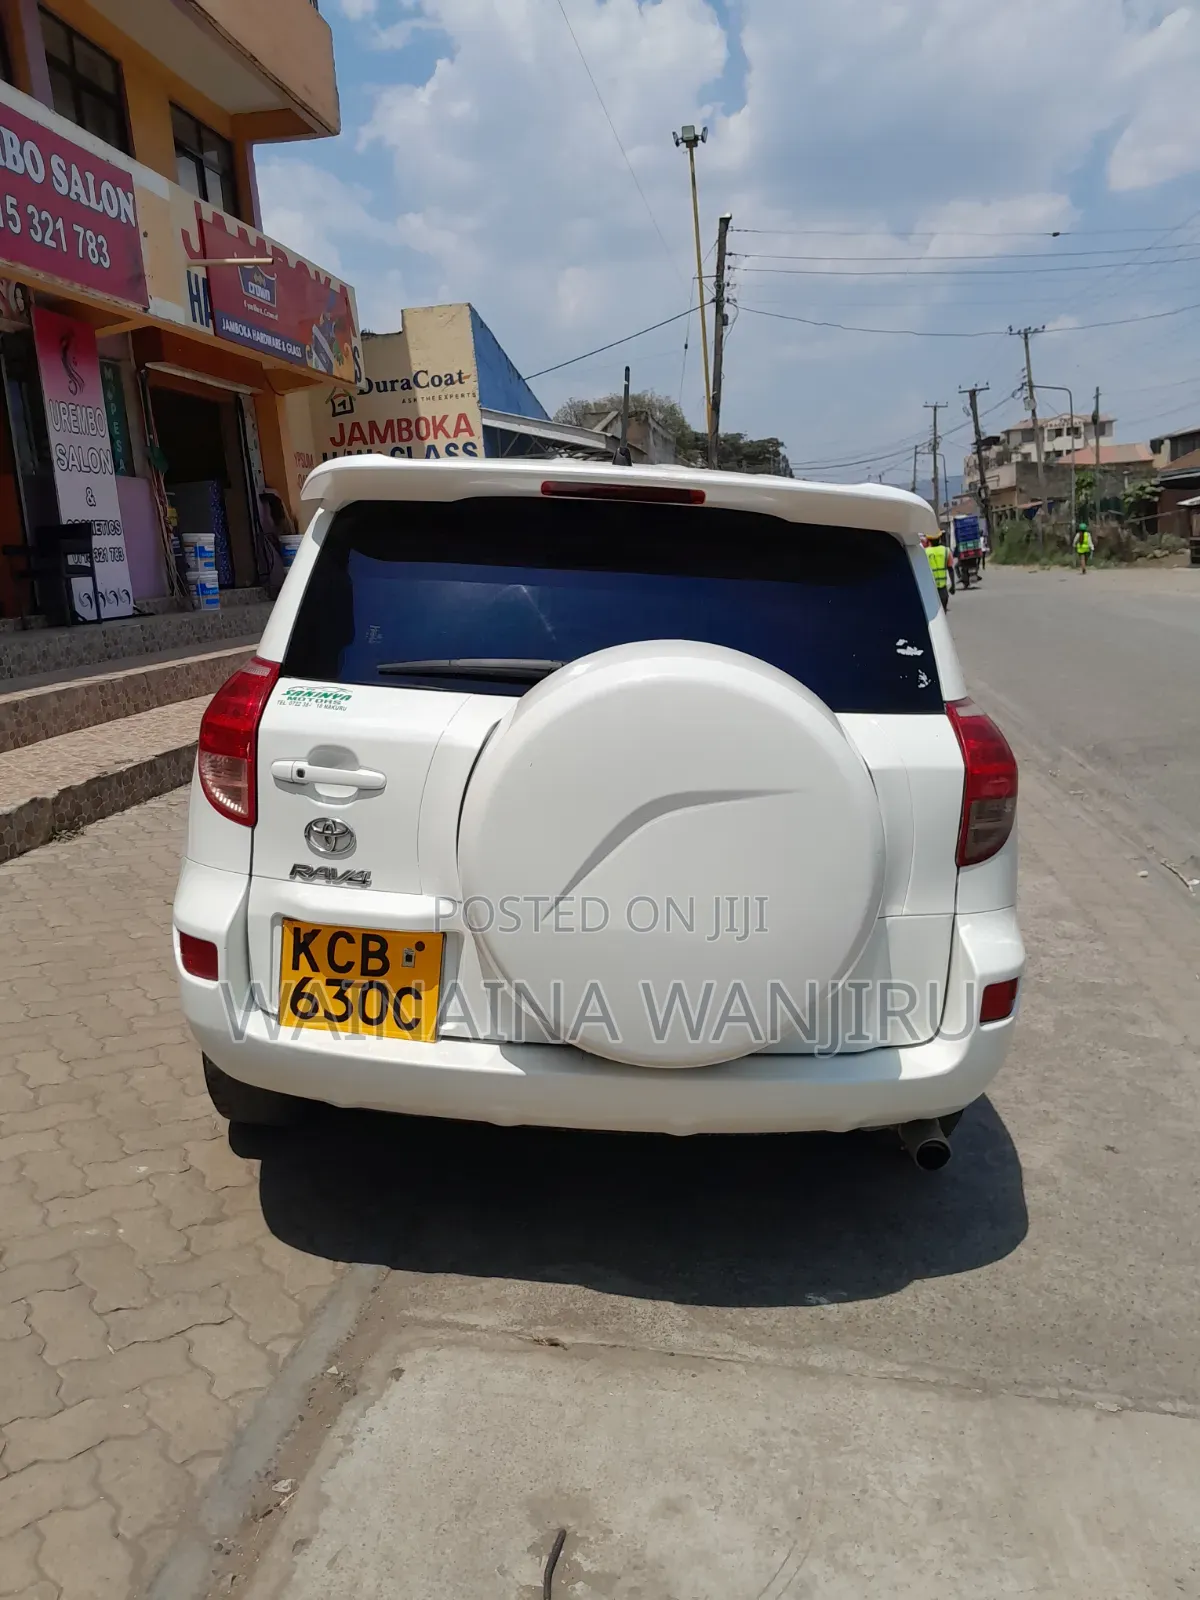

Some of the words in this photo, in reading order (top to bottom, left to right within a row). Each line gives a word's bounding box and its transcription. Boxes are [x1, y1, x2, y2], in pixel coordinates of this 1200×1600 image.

[0, 125, 46, 184] BO
[50, 153, 136, 228] SALON
[26, 204, 68, 252] 321
[72, 223, 111, 269] 783
[222, 318, 252, 340] JAMBOKA
[251, 329, 282, 351] HARDWARE
[357, 370, 465, 396] DuraCoat
[438, 392, 477, 401] EXPERTS
[49, 399, 106, 439] UREMBO
[330, 412, 475, 447] JAMBOKA
[55, 443, 113, 476] SALON
[86, 486, 96, 507] &
[67, 519, 122, 536] ETICS
[93, 547, 109, 563] 321
[287, 696, 342, 705] MOTORS
[290, 863, 372, 888] RAV4
[291, 927, 391, 978] KCB
[289, 976, 424, 1031] 630C
